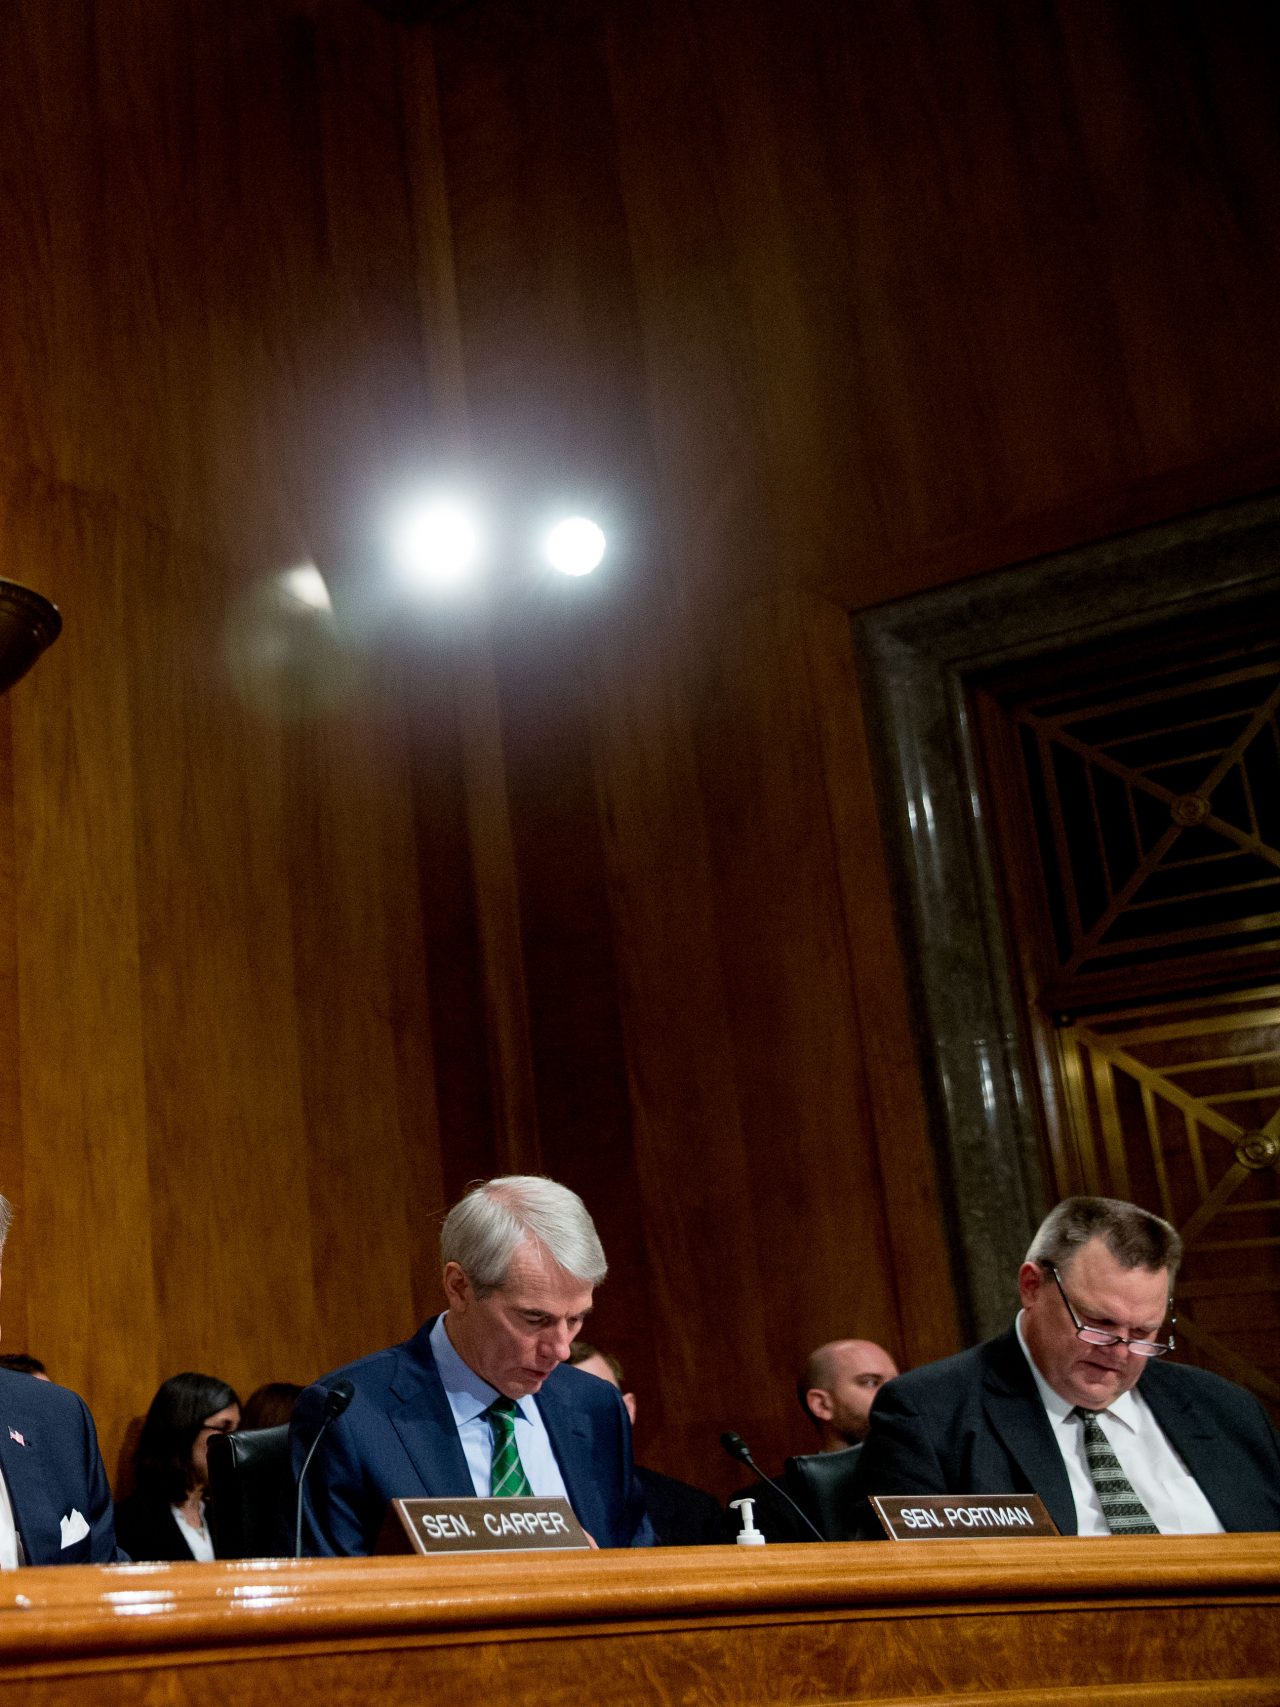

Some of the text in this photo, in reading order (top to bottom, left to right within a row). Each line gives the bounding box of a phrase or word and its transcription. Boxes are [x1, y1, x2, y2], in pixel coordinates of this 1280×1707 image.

[422, 1512, 570, 1538] SEN. CARPER
[900, 1507, 1034, 1528] SEN. PORTMAN
